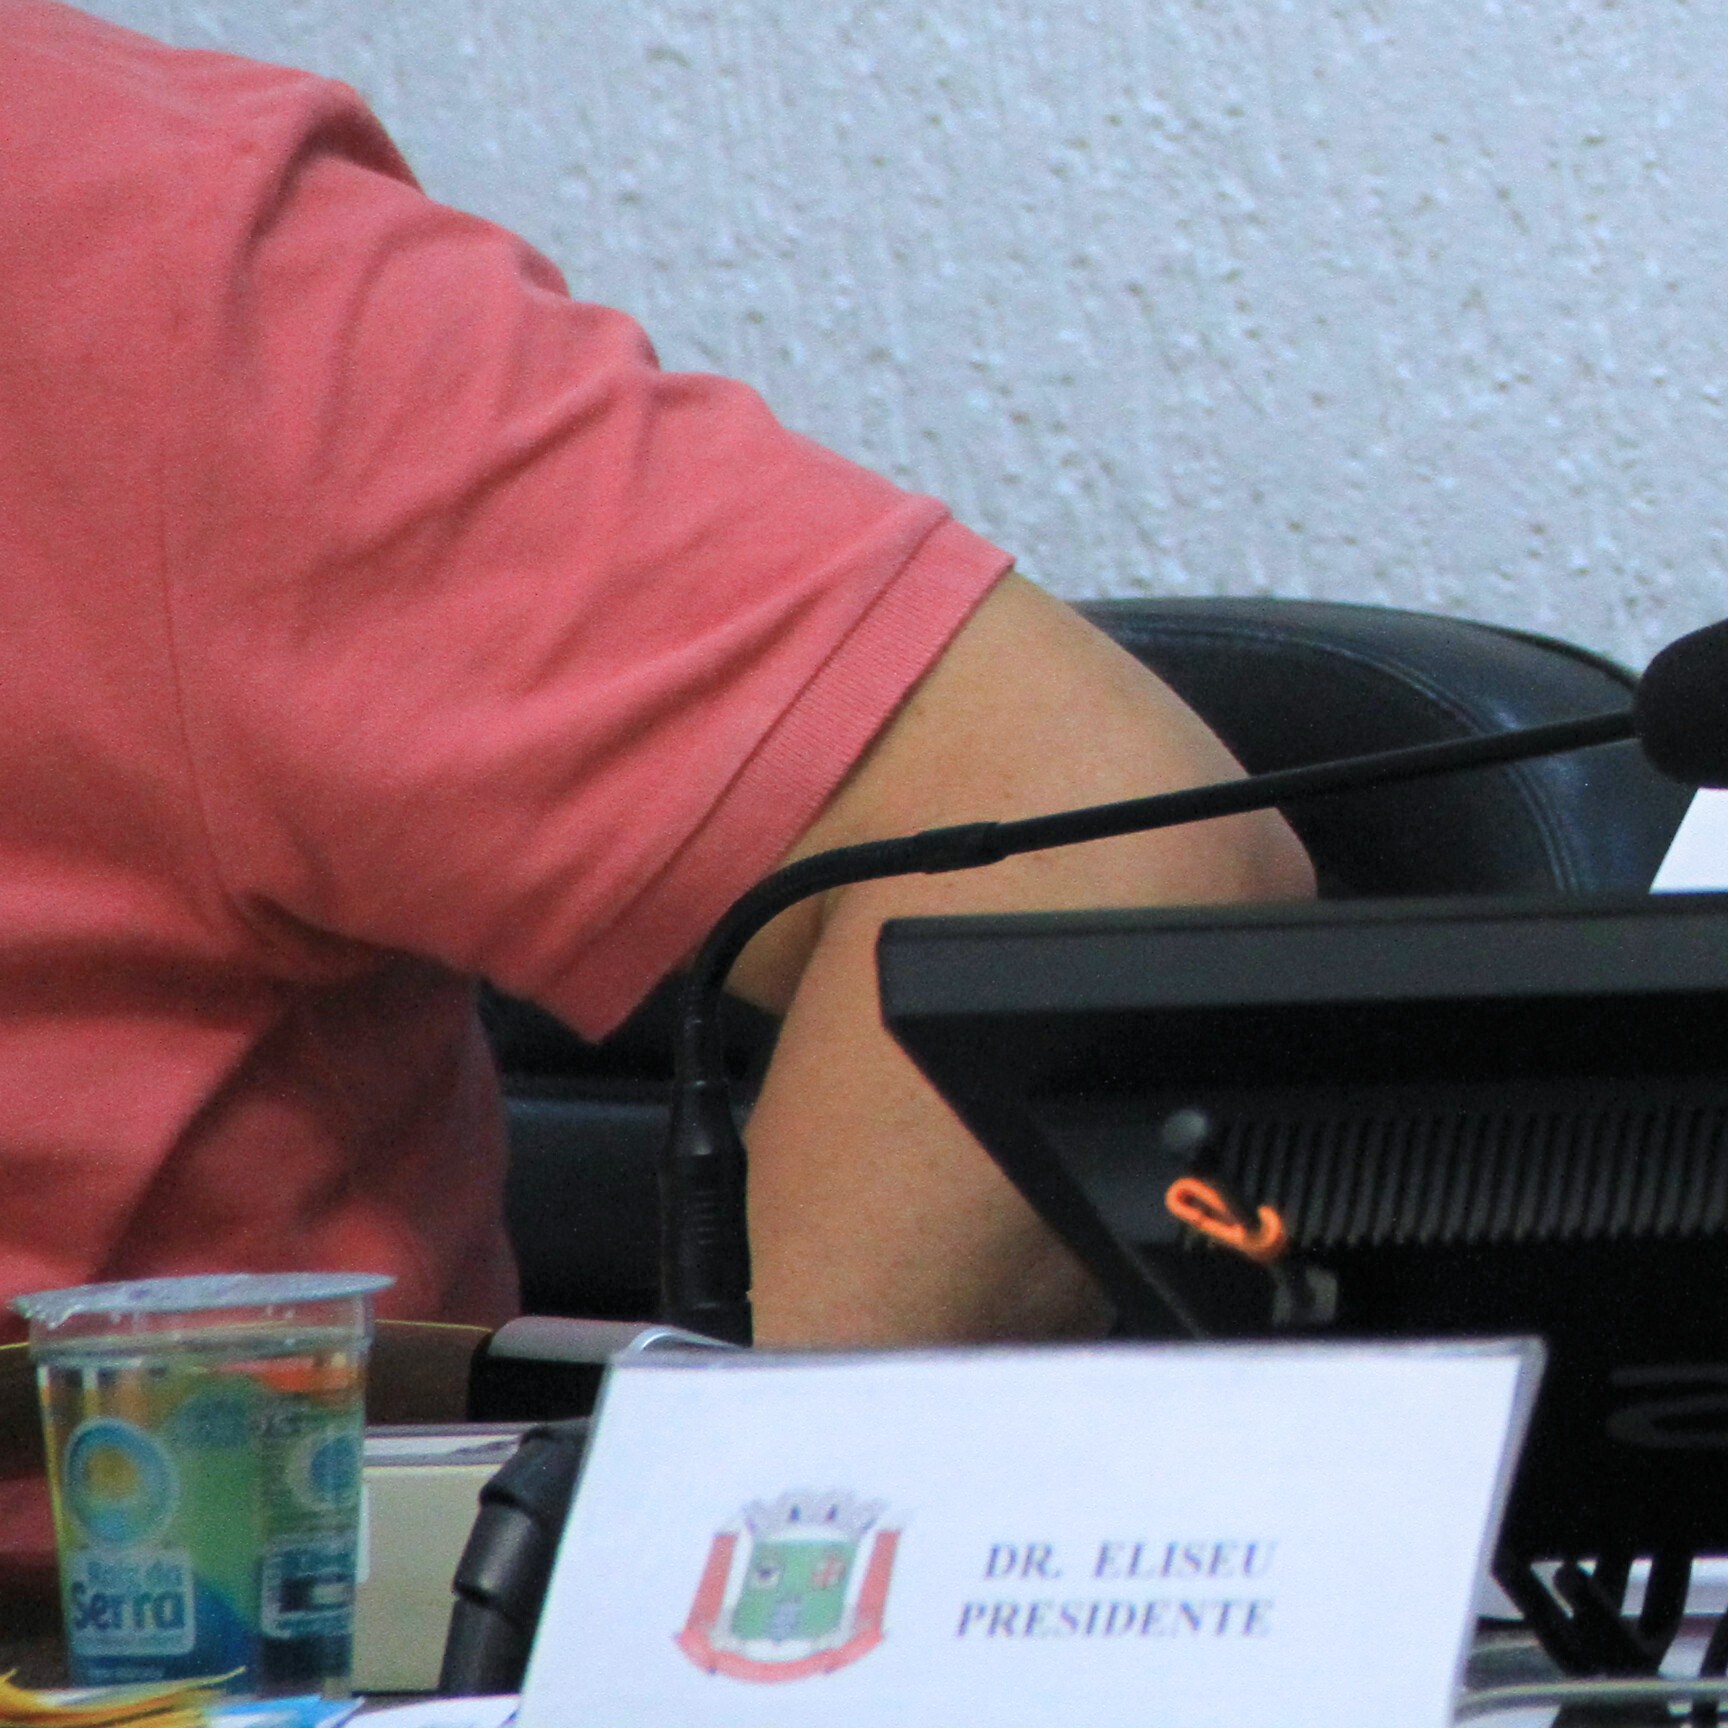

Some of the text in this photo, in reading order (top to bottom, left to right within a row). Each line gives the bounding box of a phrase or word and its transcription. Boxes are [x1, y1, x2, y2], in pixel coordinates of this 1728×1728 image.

[984, 1538, 1277, 1579] DR. ELISEU
[955, 1599, 1275, 1638] PRESIDENTE
